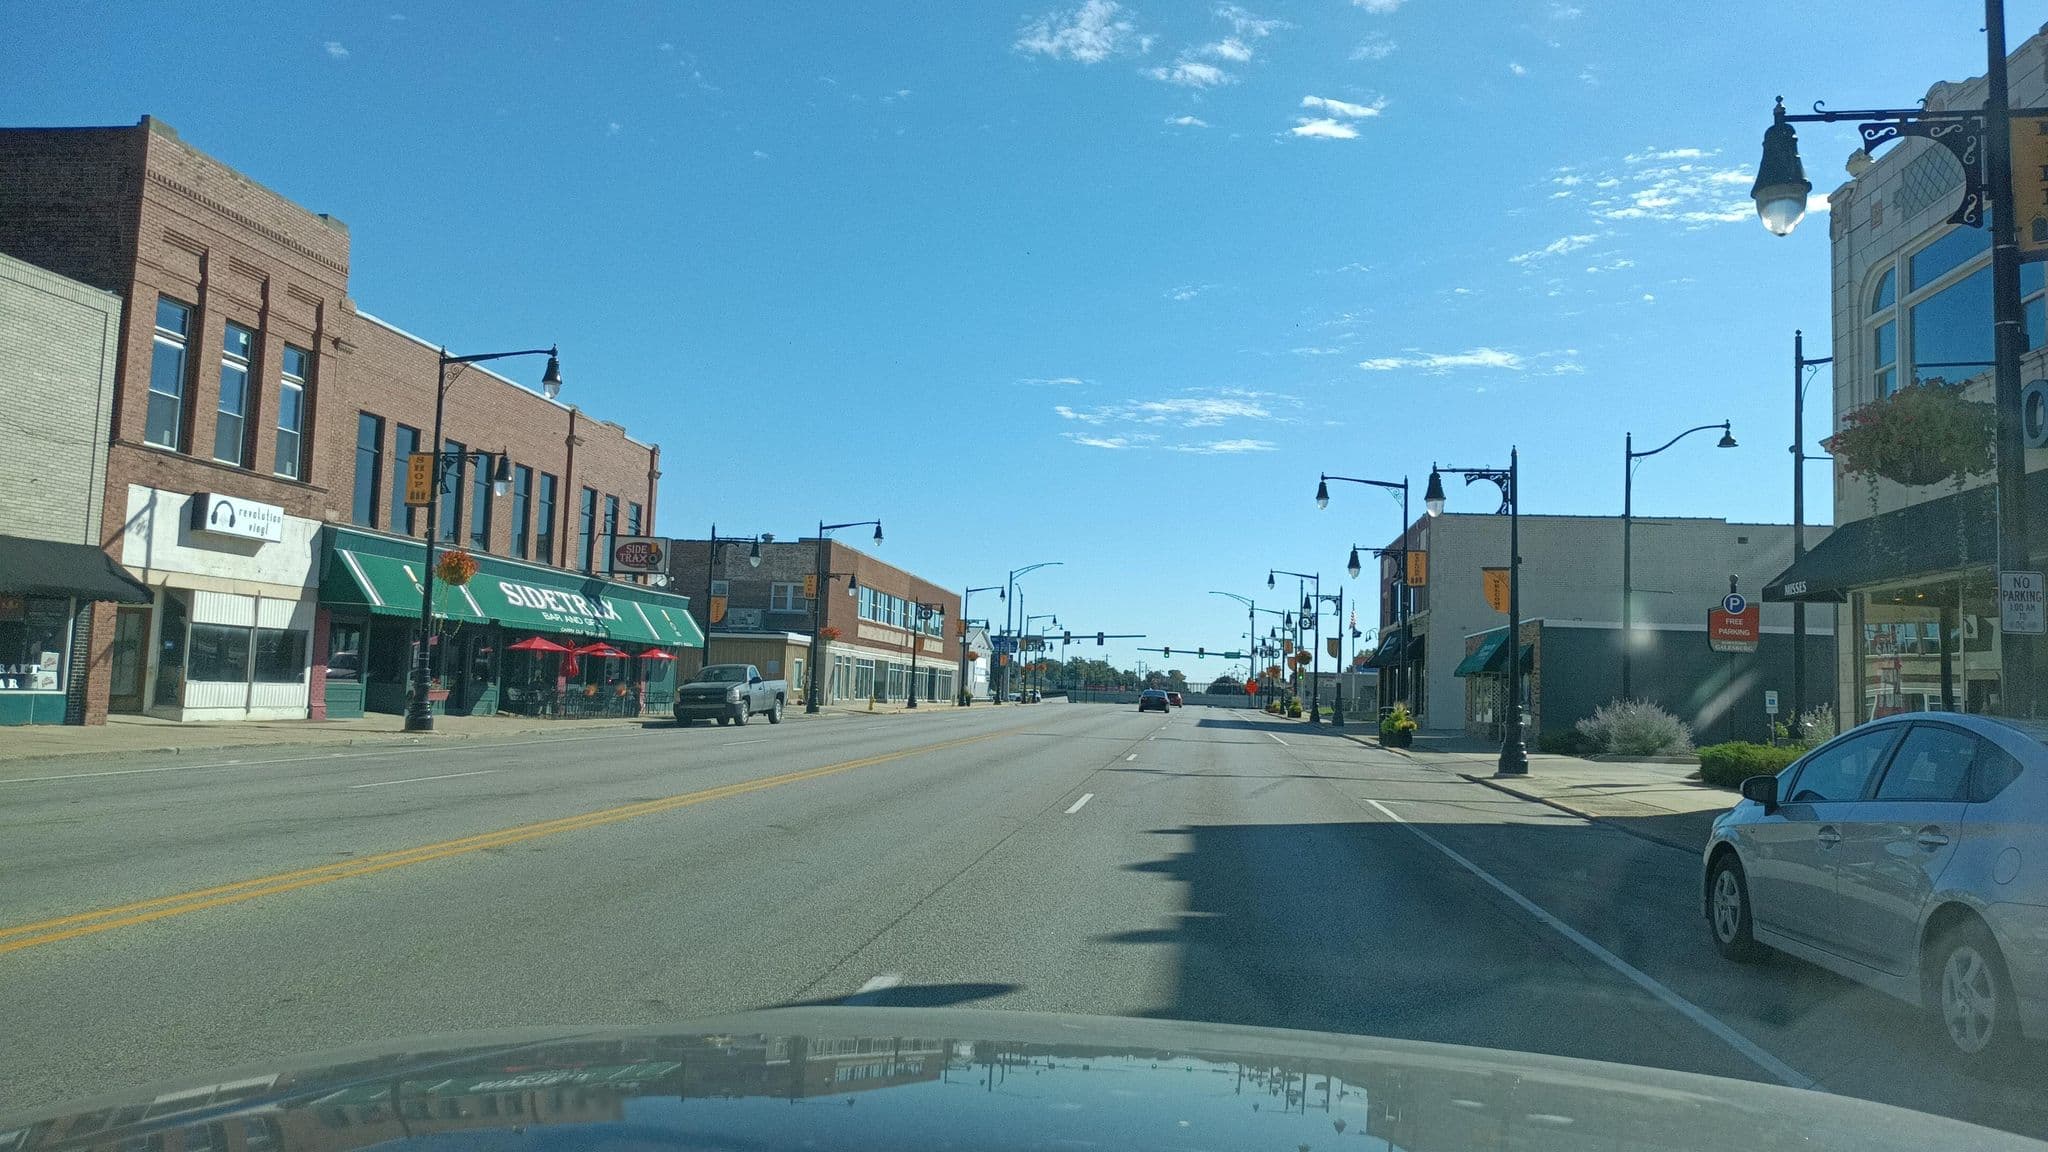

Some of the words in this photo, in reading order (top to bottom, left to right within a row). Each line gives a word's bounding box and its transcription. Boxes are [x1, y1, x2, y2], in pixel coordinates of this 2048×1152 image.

[414, 456, 425, 488] SHOP
[239, 507, 281, 523] revolution
[249, 522, 269, 536] vinyl
[626, 544, 648, 554] SIDE
[620, 553, 648, 563] TRAX
[1784, 581, 1807, 596] MISSES
[2013, 577, 2030, 589] NO
[2003, 590, 2042, 602] PARKING
[1729, 597, 1740, 610] P
[541, 611, 563, 622] BAR
[564, 615, 583, 625] AND
[1718, 628, 1750, 636] PARKING
